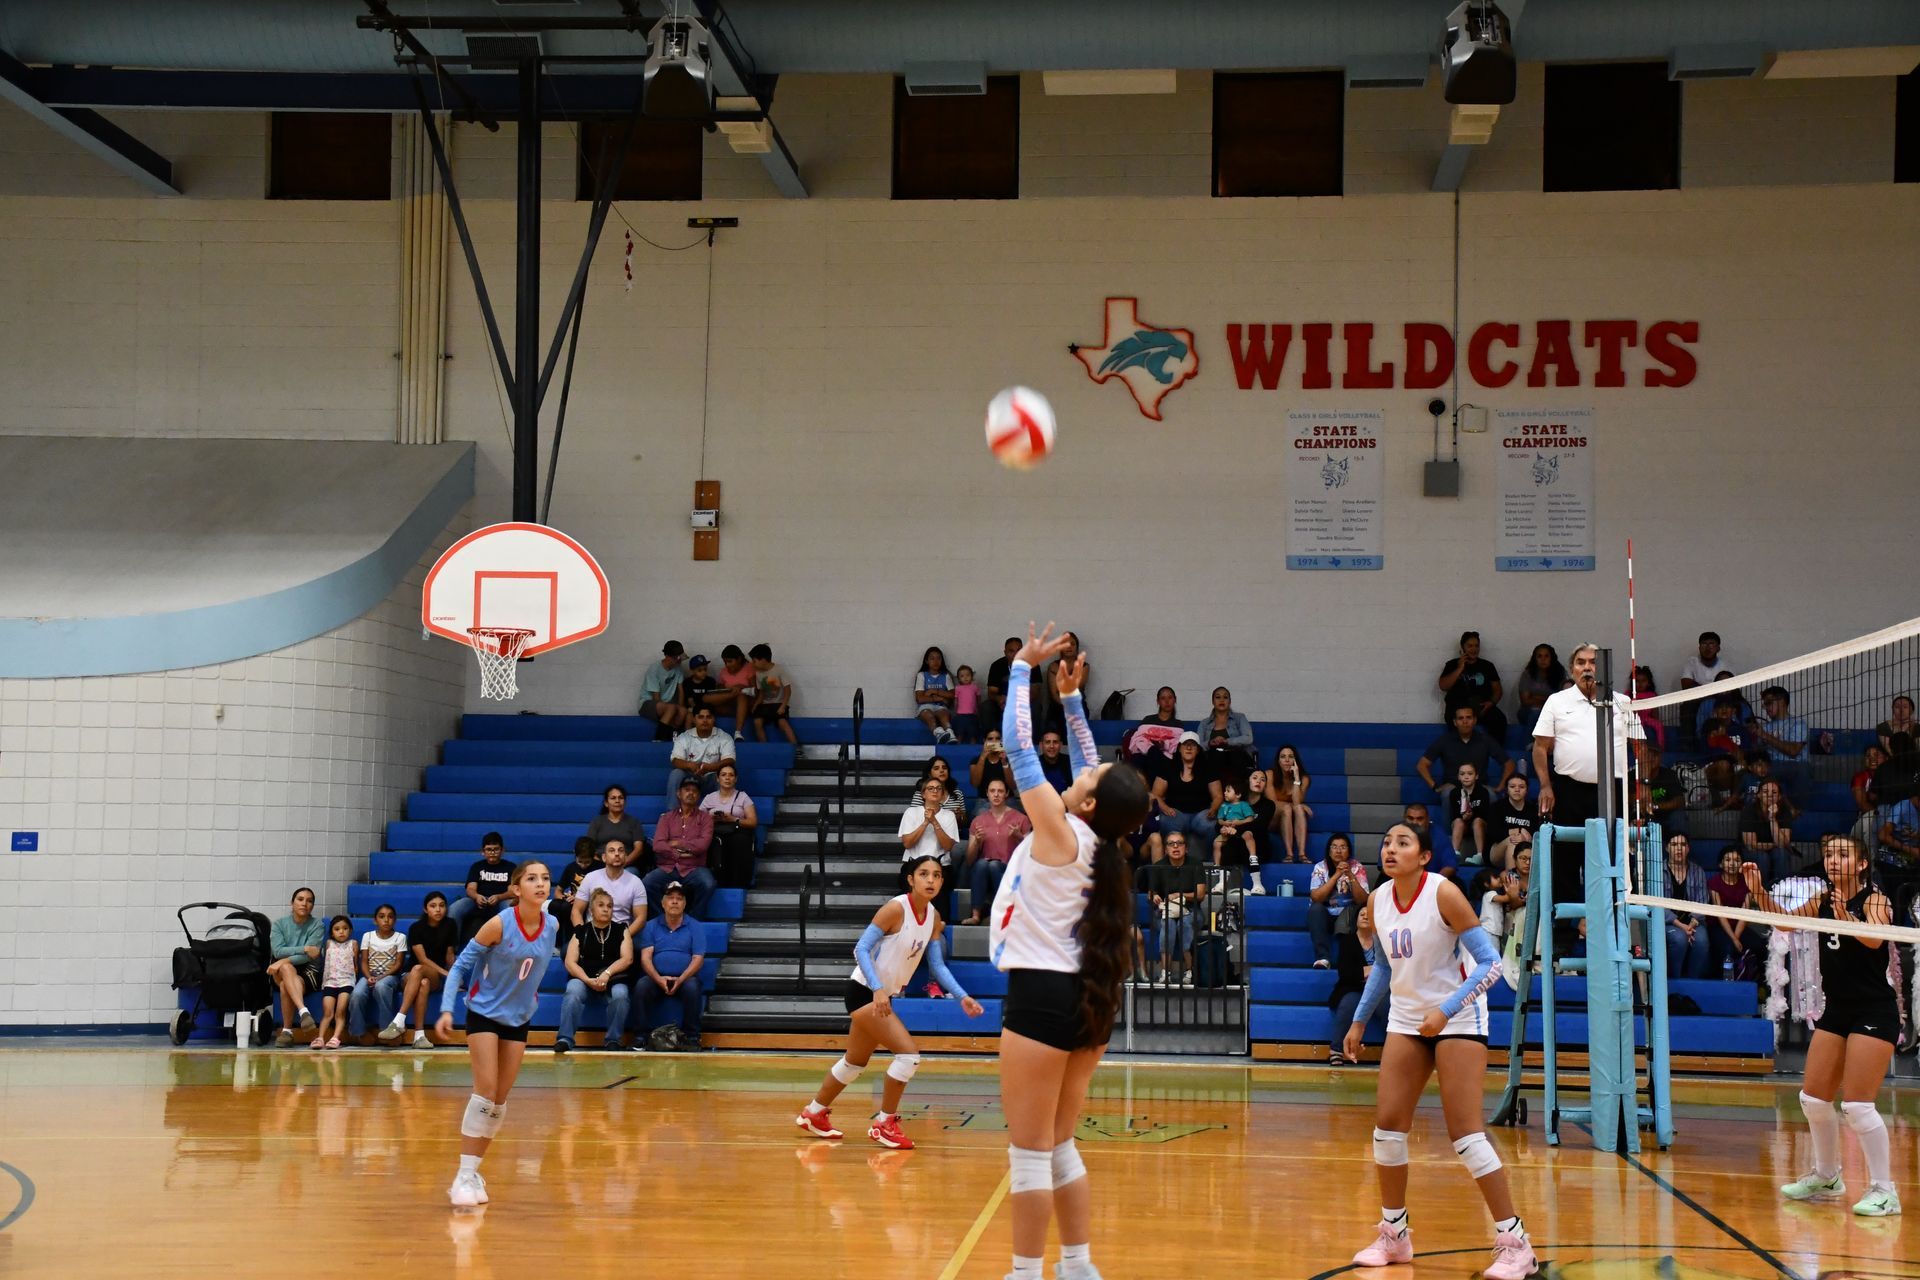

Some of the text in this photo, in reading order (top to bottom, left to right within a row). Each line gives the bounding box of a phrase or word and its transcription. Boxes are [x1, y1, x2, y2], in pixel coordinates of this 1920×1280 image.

[1227, 319, 1698, 389] WILDCATS
[1313, 426, 1357, 436] STATE
[1522, 425, 1567, 435] STATE
[1294, 438, 1376, 449] CHAMPIONS
[1502, 437, 1587, 448] CHAMPIONS
[1297, 558, 1372, 566] 1974 1975
[1507, 559, 1585, 567] 1975 1976
[1015, 685, 1033, 749] WILDCATS
[1389, 928, 1413, 958] 10
[518, 957, 534, 981] 0
[1461, 960, 1503, 1007] WILDCATS
